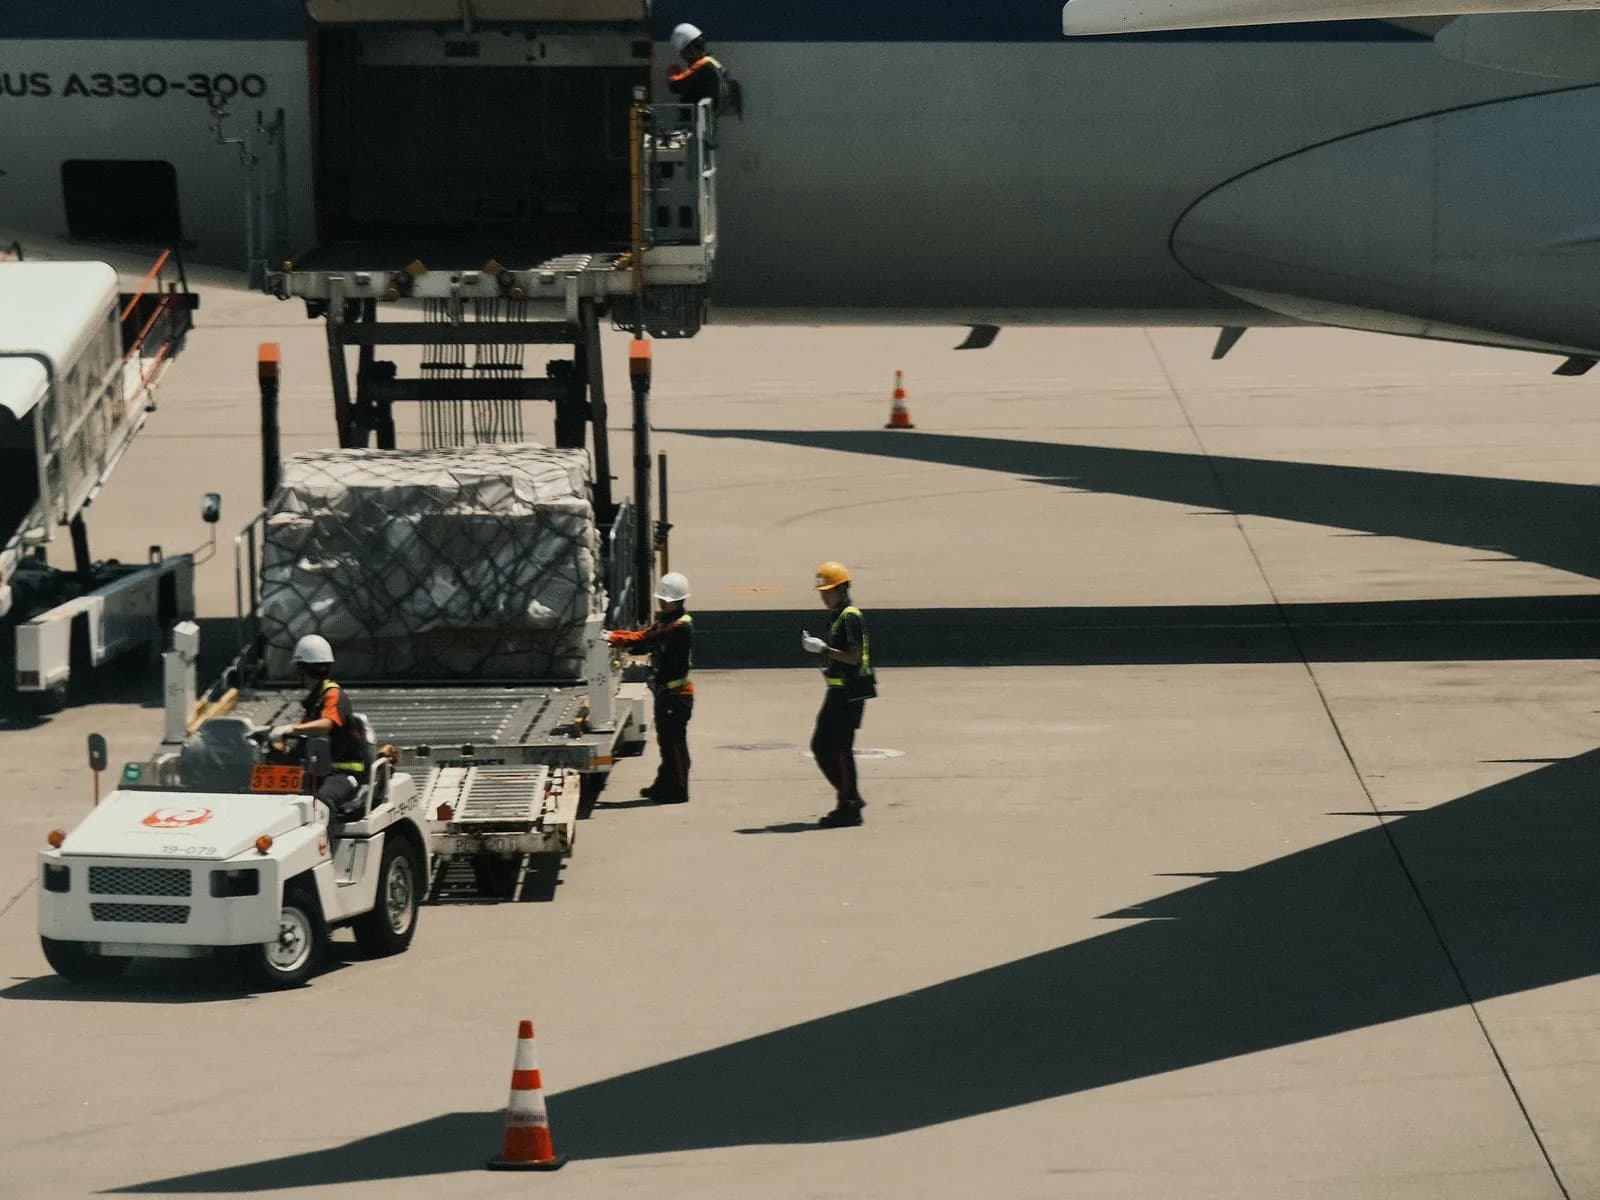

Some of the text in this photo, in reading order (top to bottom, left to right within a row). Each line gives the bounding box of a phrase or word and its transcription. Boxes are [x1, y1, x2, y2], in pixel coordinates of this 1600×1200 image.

[0, 72, 267, 98] US A330-300
[162, 845, 217, 856] 19-079
